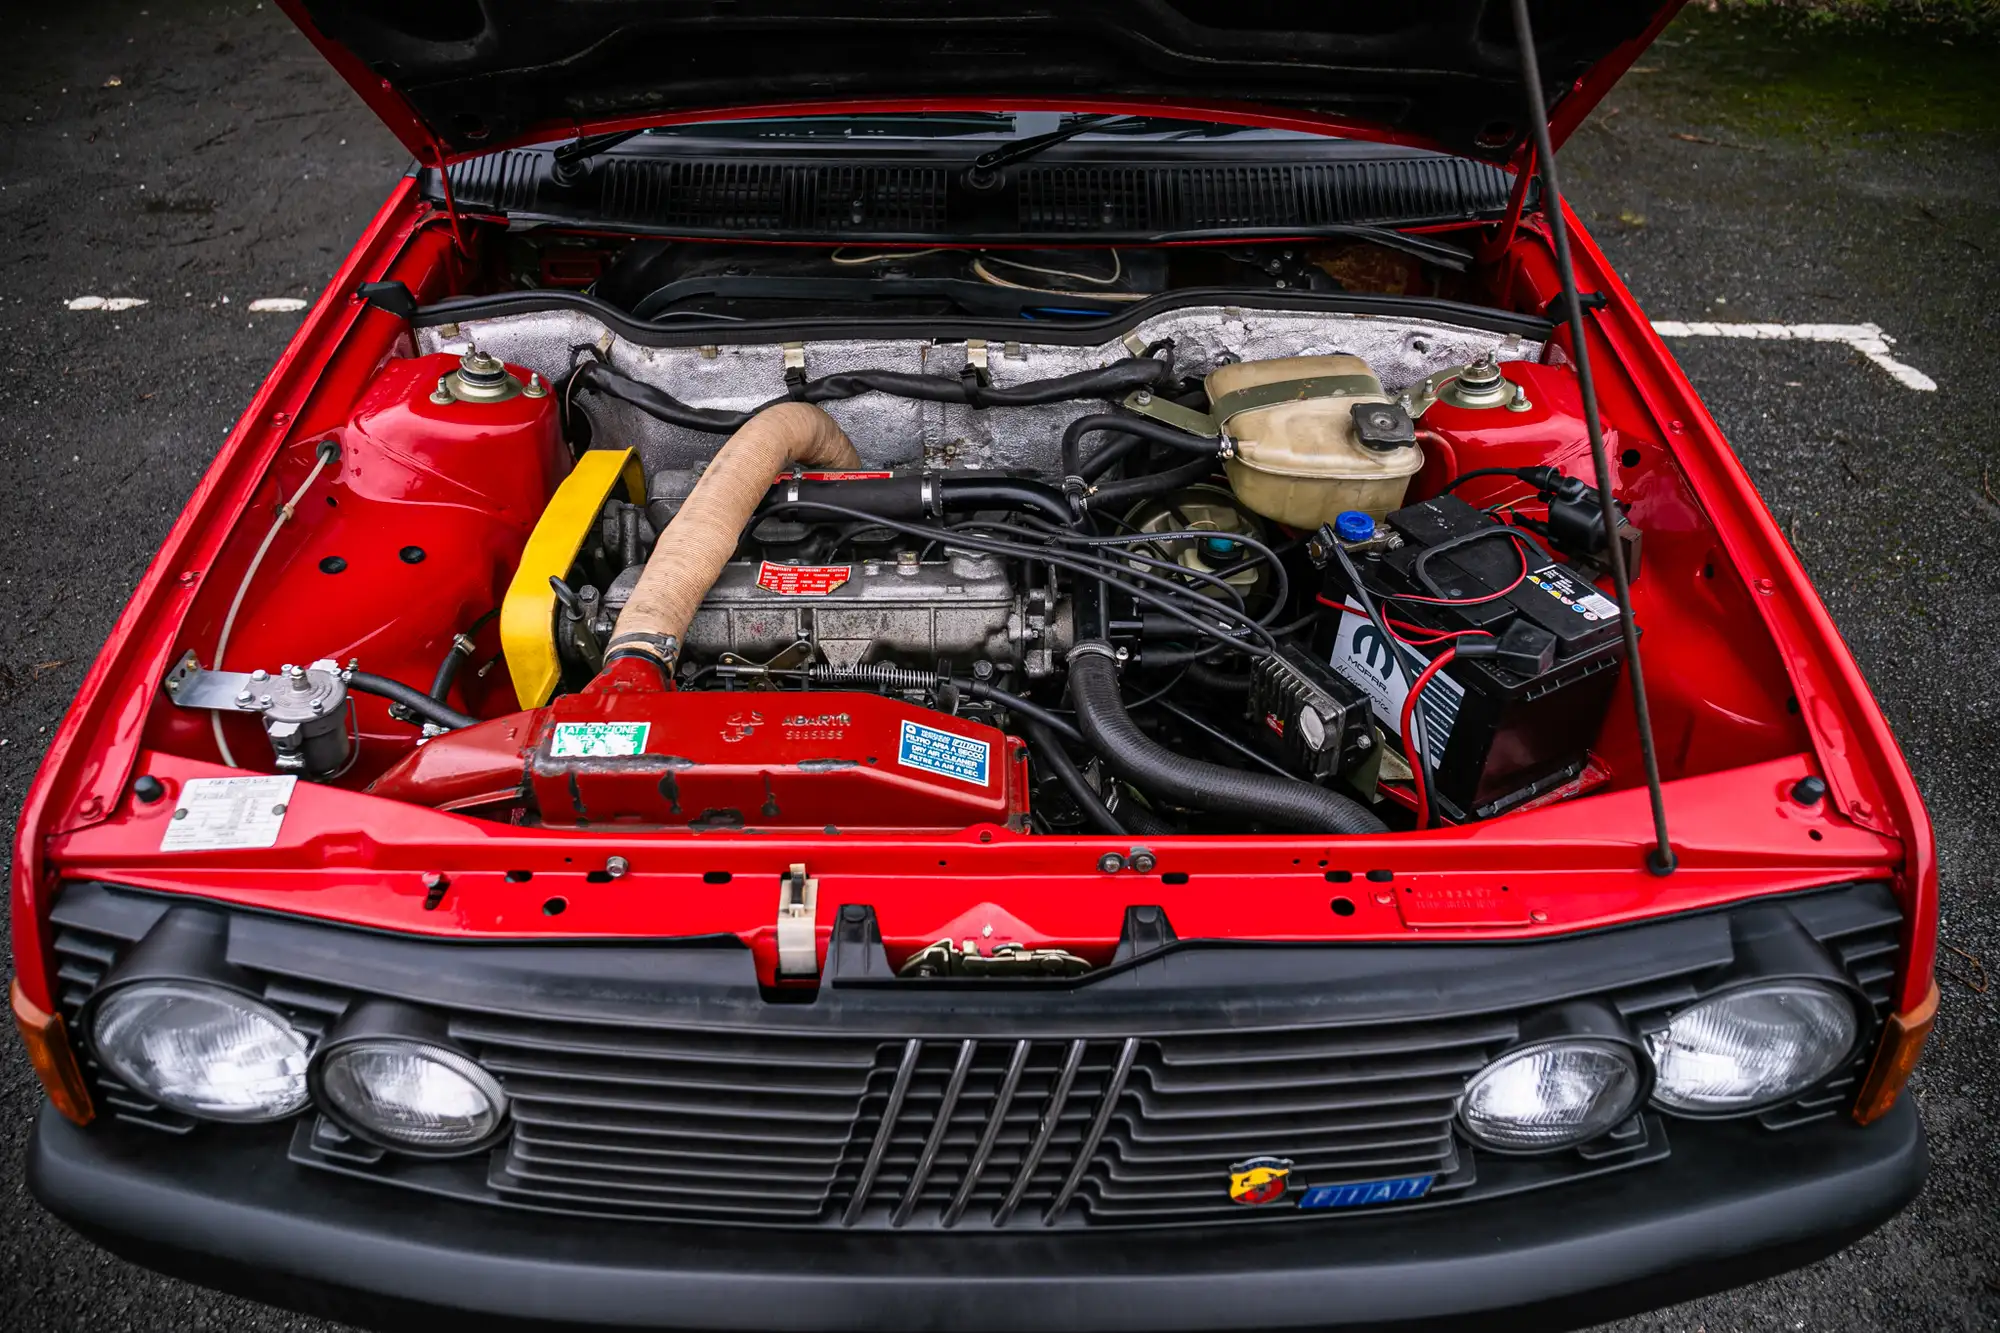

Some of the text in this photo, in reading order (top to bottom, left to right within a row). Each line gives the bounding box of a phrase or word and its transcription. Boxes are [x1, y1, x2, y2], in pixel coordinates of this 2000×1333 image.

[566, 725, 638, 735] ATTENZIONE
[781, 713, 851, 727] ABARTH
[905, 733, 931, 746] FILTRO
[932, 741, 950, 752] ARIA
[957, 747, 984, 760] SECCO
[911, 745, 927, 754] DRY
[927, 749, 941, 758] AIR
[941, 753, 978, 768] CLEANER
[909, 754, 933, 766] FILTRE
[941, 763, 955, 771] AIR
[963, 768, 979, 778] SEC
[1312, 1180, 1421, 1205] FIAT
